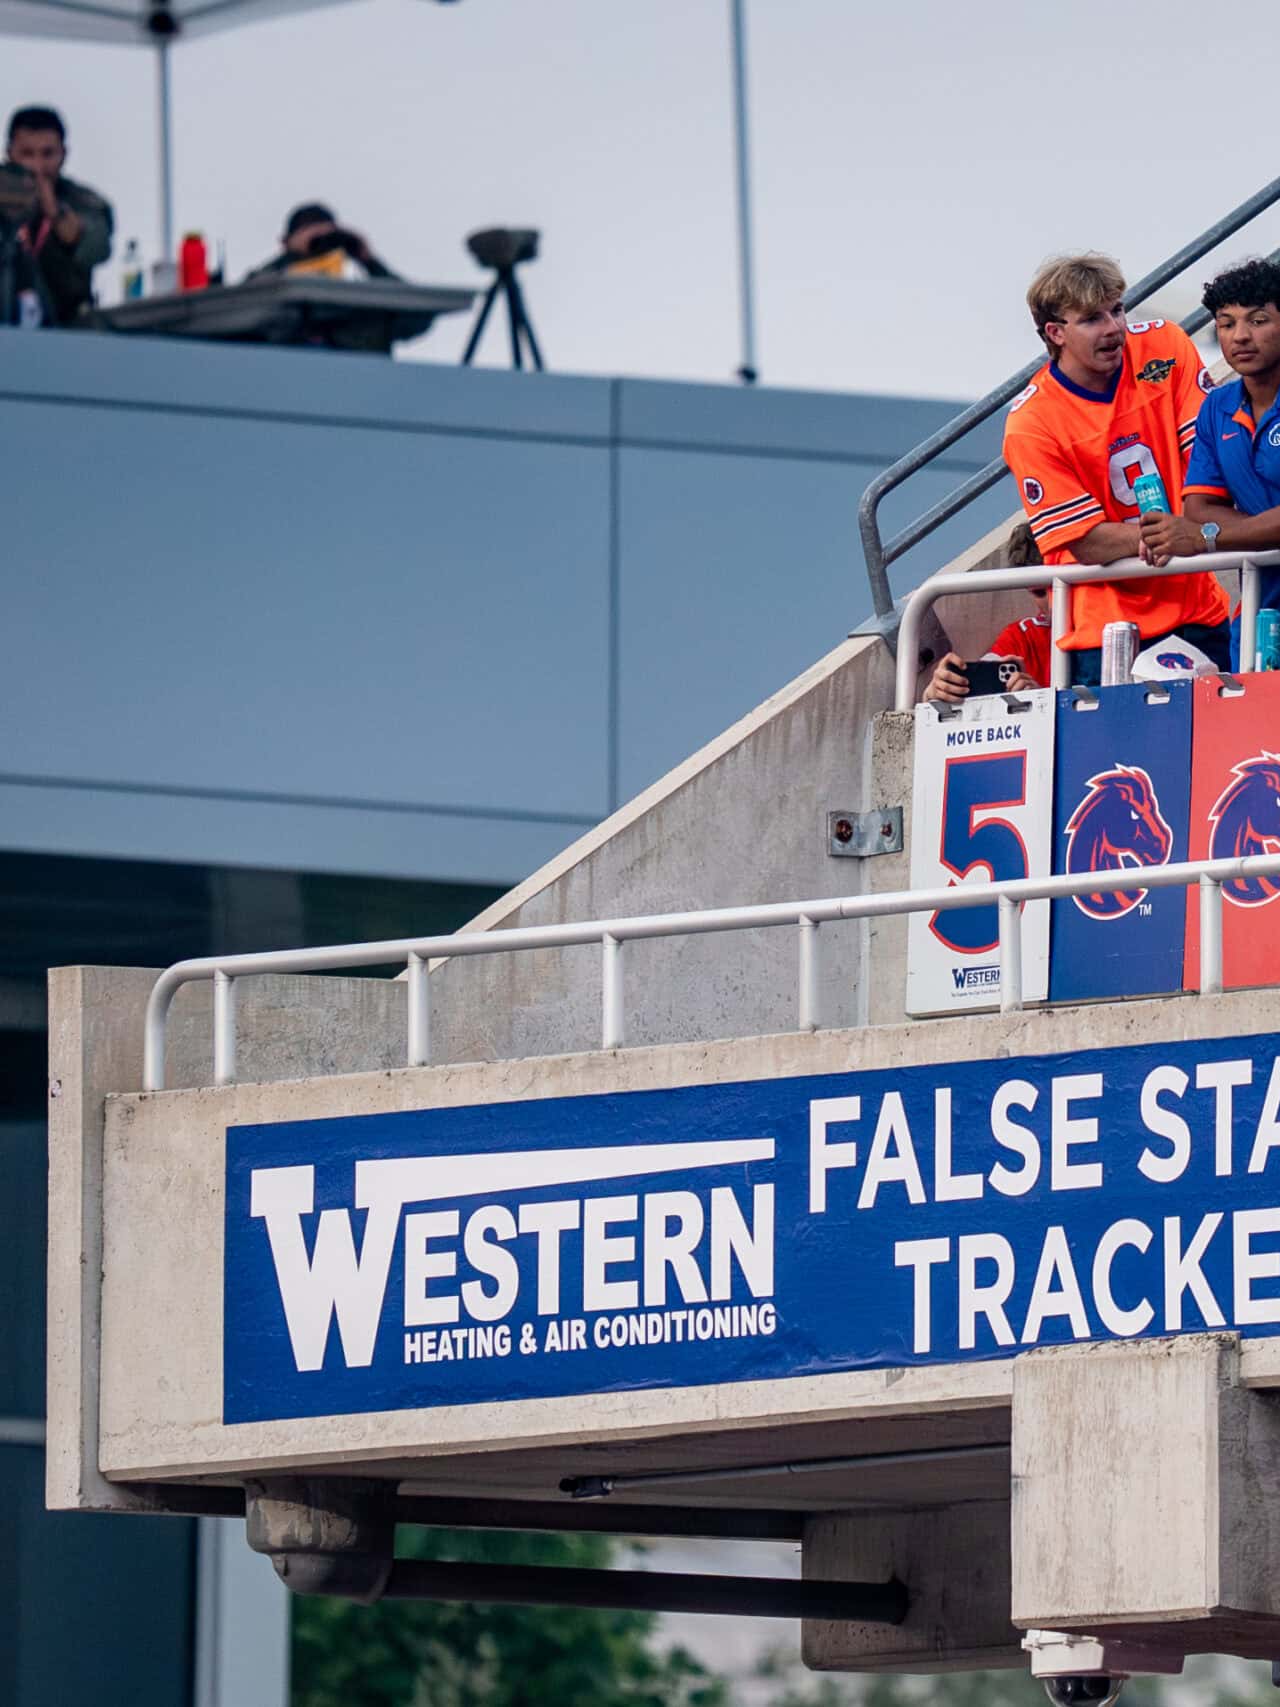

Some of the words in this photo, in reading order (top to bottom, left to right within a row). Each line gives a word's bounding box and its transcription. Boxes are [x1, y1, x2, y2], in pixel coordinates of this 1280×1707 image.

[946, 729, 983, 746] MOVE
[987, 724, 1021, 742] BACK
[928, 749, 1030, 954] 5
[1138, 903, 1152, 917] TM
[809, 1073, 1103, 1213] FALSE
[250, 1138, 776, 1372] WESTERN
[404, 1325, 512, 1364] HEATING
[520, 1322, 538, 1355] &
[544, 1317, 588, 1353] AIR
[594, 1303, 777, 1348] CONDITIONING
